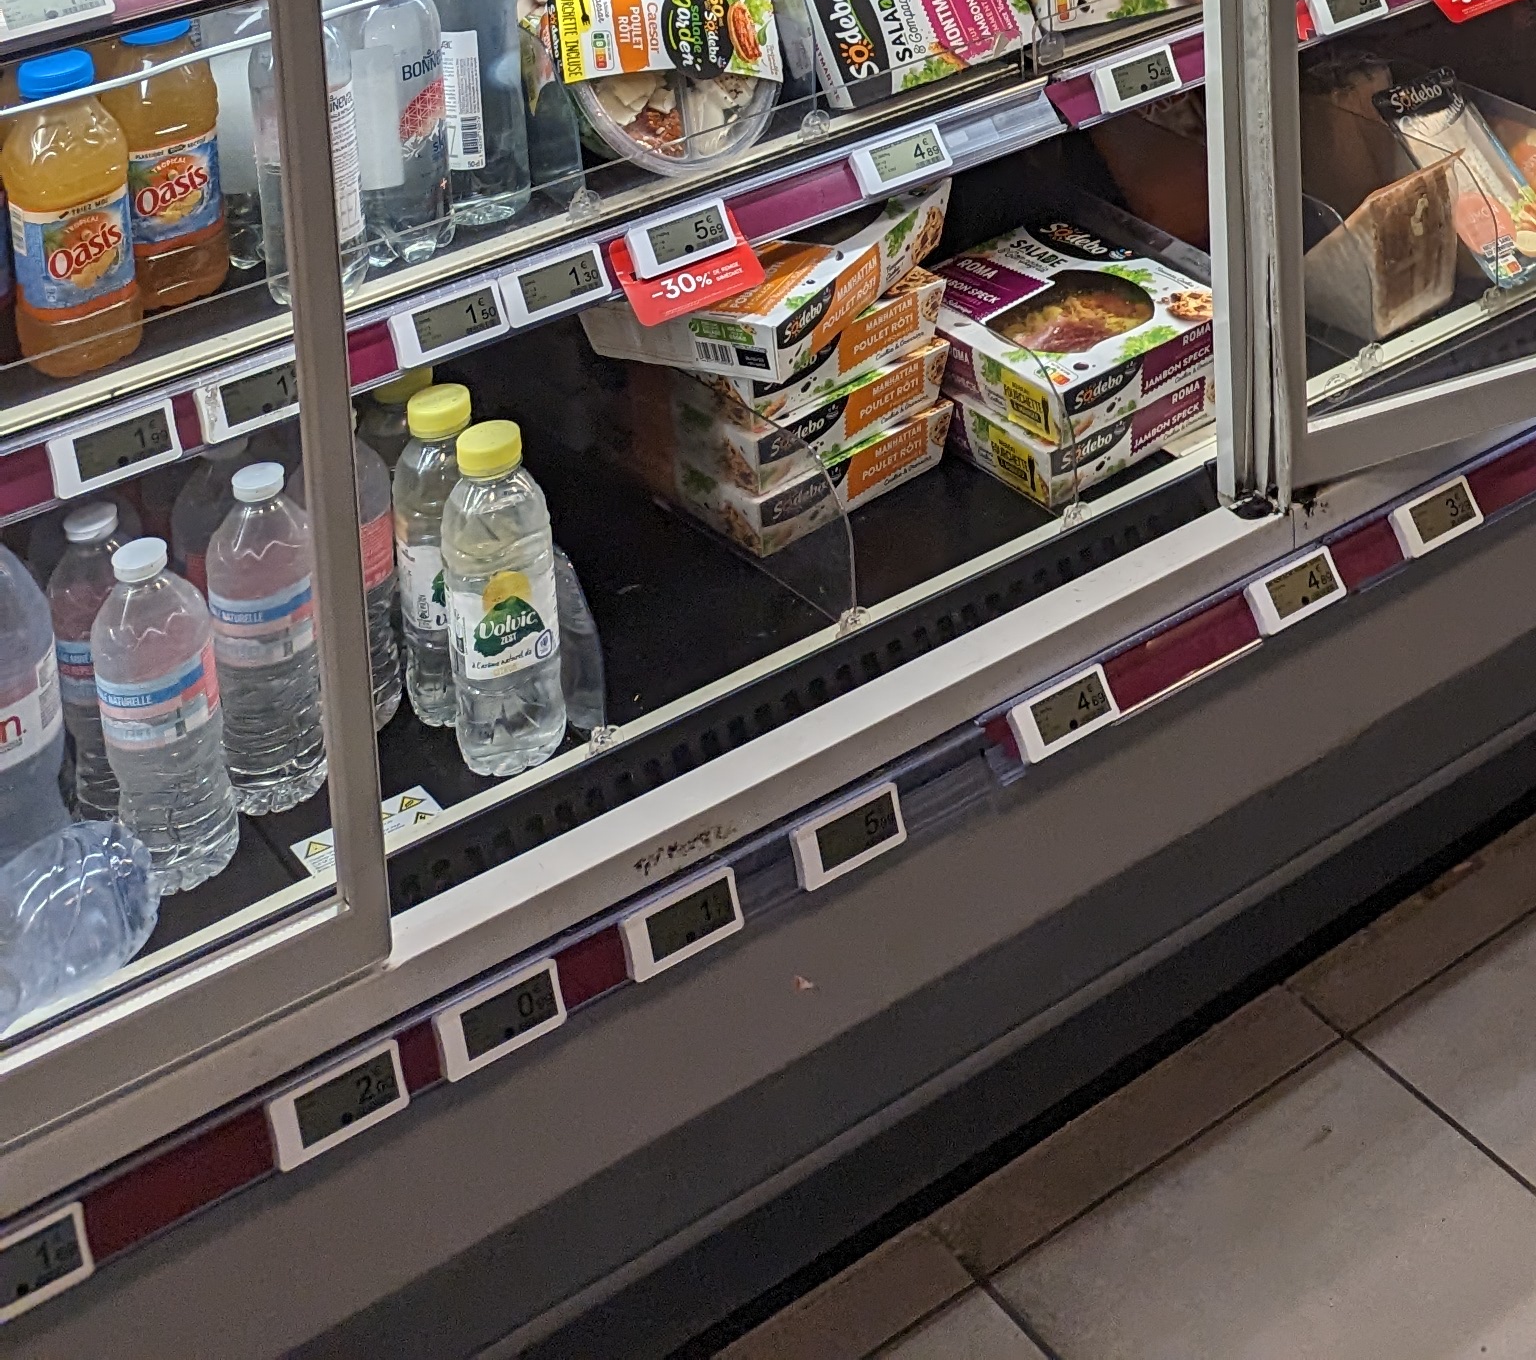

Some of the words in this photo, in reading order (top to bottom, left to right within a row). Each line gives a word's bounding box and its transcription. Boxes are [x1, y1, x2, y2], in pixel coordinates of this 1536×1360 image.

[617, 15, 632, 44] RÔTI
[629, 6, 643, 51] POULET
[646, 2, 660, 54] Caesar
[691, 4, 702, 53] salade
[704, 11, 720, 64] Sodebo
[565, 40, 581, 77] INCLUSE
[1391, 81, 1443, 113] Sodebo
[134, 163, 208, 217] Oasis
[48, 221, 123, 281] Oasis
[1009, 238, 1068, 270] SALADE
[1039, 224, 1109, 257] Sodebo
[651, 272, 713, 302] -30%
[836, 255, 878, 303] MANHATTAN
[956, 258, 996, 281] ROMA
[783, 301, 823, 345] Sodebo
[821, 298, 854, 333] POULET
[855, 277, 878, 306] RÔTI
[853, 325, 892, 356] POULET
[892, 313, 915, 336] RÔTI
[1181, 322, 1212, 347] ROMA
[1144, 361, 1183, 391] JAMBON
[1183, 345, 1212, 372] SPECK
[859, 391, 896, 419] POULET
[897, 376, 920, 401] RÔTI
[1075, 373, 1124, 410] Sodebo
[1171, 381, 1201, 405] ROMA
[1134, 418, 1171, 450] JAMBON
[1172, 402, 1201, 428] SPECK
[862, 452, 900, 481] POULET
[900, 438, 923, 462] RÔTI
[1061, 431, 1114, 469] Sodebo
[479, 609, 538, 638] Volvic
[500, 633, 518, 645] ZEST
